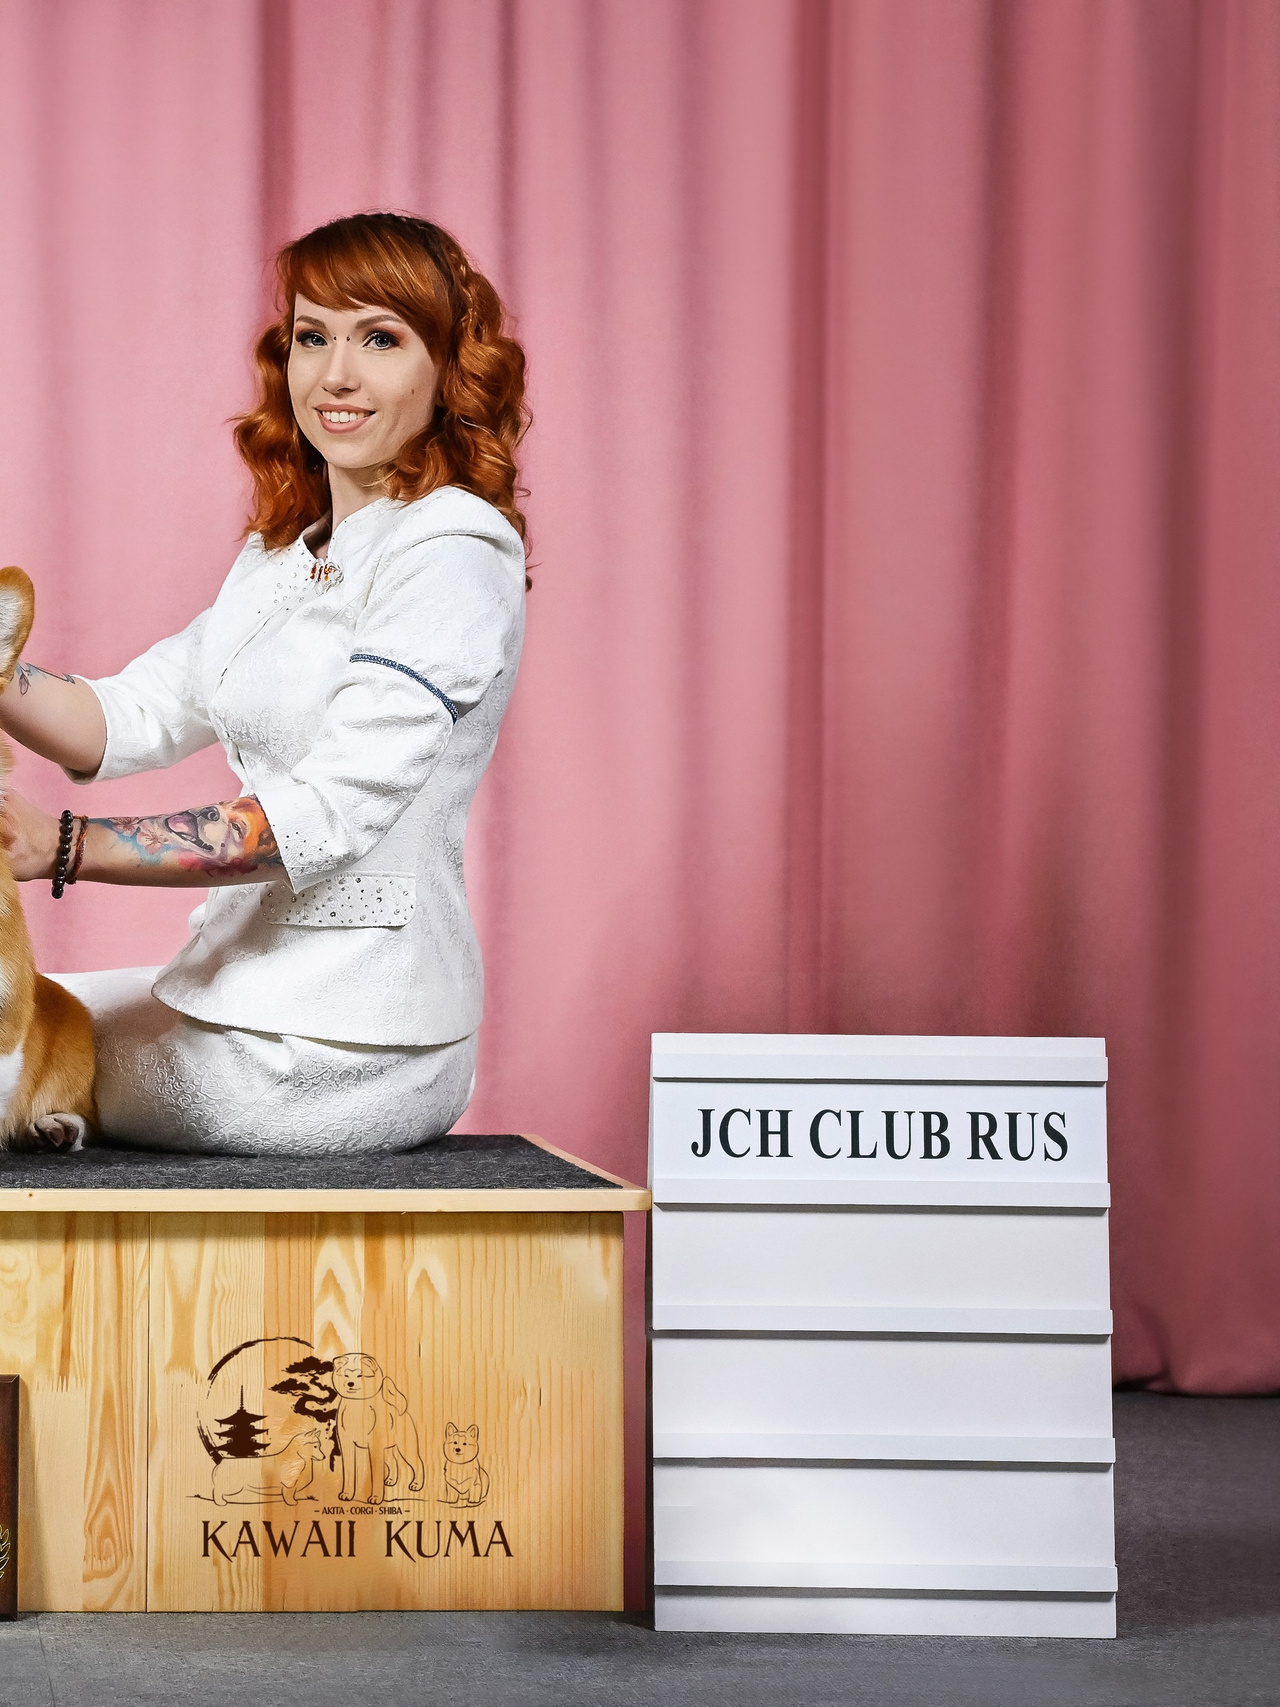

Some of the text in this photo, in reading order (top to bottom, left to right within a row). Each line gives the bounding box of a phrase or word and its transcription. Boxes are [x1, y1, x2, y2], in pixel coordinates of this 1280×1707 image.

[690, 1108, 1069, 1162] JCH CLUB RUS
[322, 1506, 403, 1515] AKITA CORGI SHIBA
[201, 1520, 514, 1563] KAWAII KUMA
